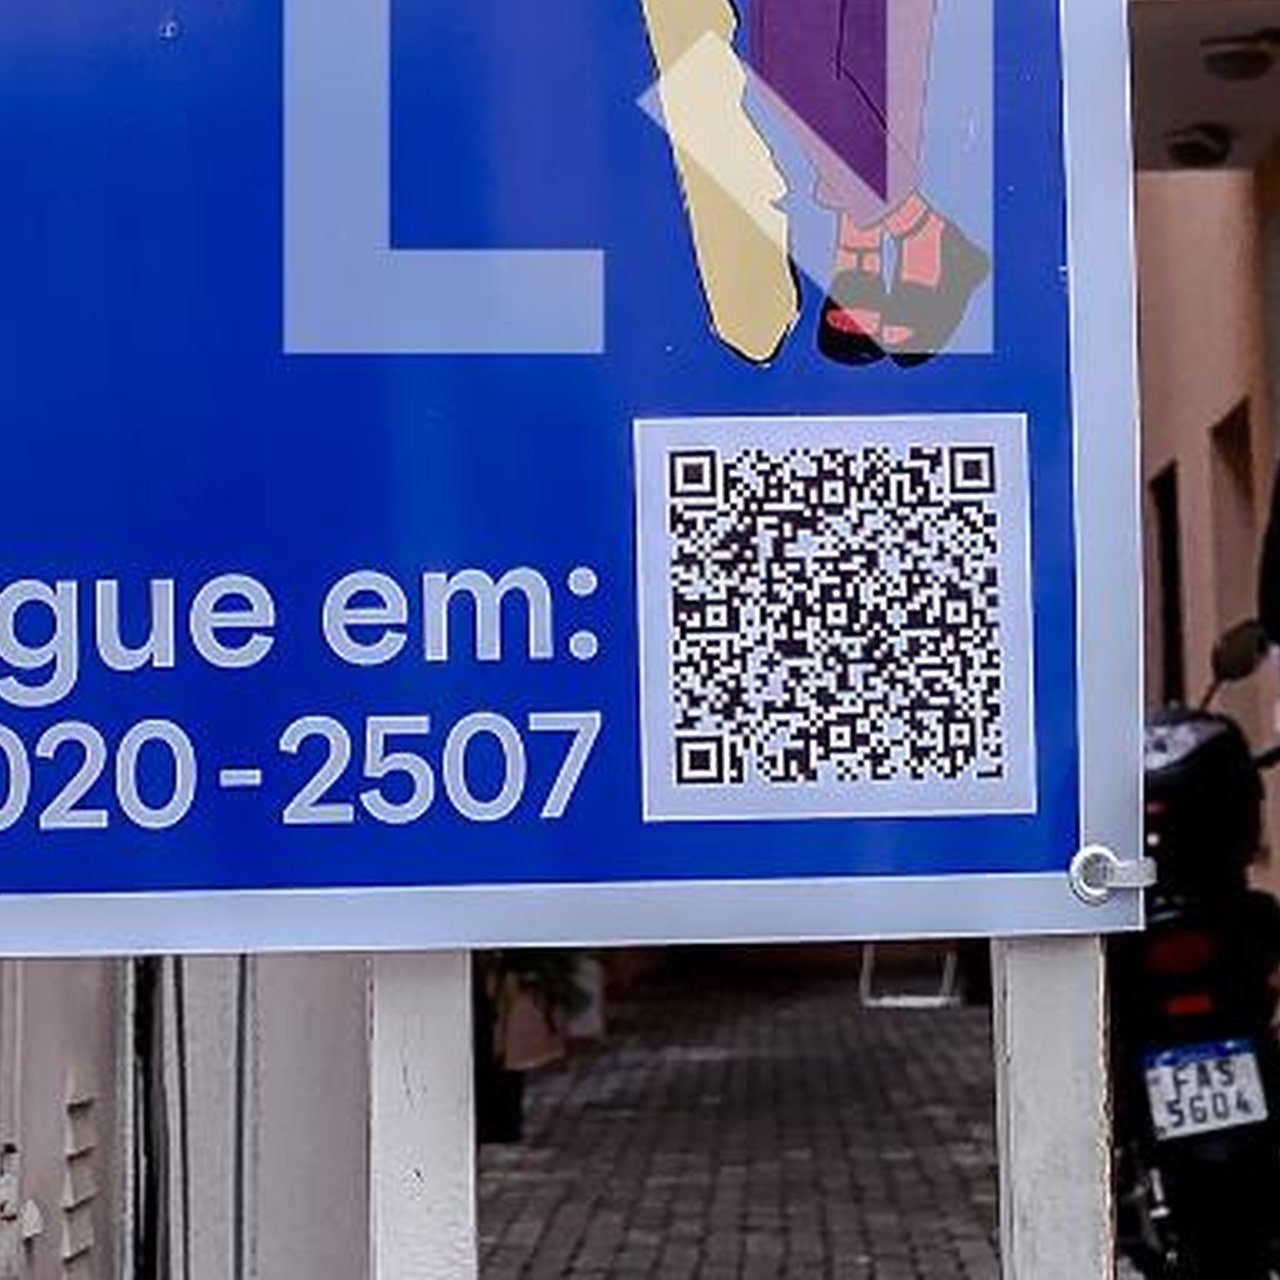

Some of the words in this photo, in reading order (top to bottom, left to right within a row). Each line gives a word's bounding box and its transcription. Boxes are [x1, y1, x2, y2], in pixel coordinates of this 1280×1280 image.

[321, 565, 600, 666] em:
[1172, 1060, 1235, 1100] FAS
[1166, 1090, 1254, 1129] 5604
